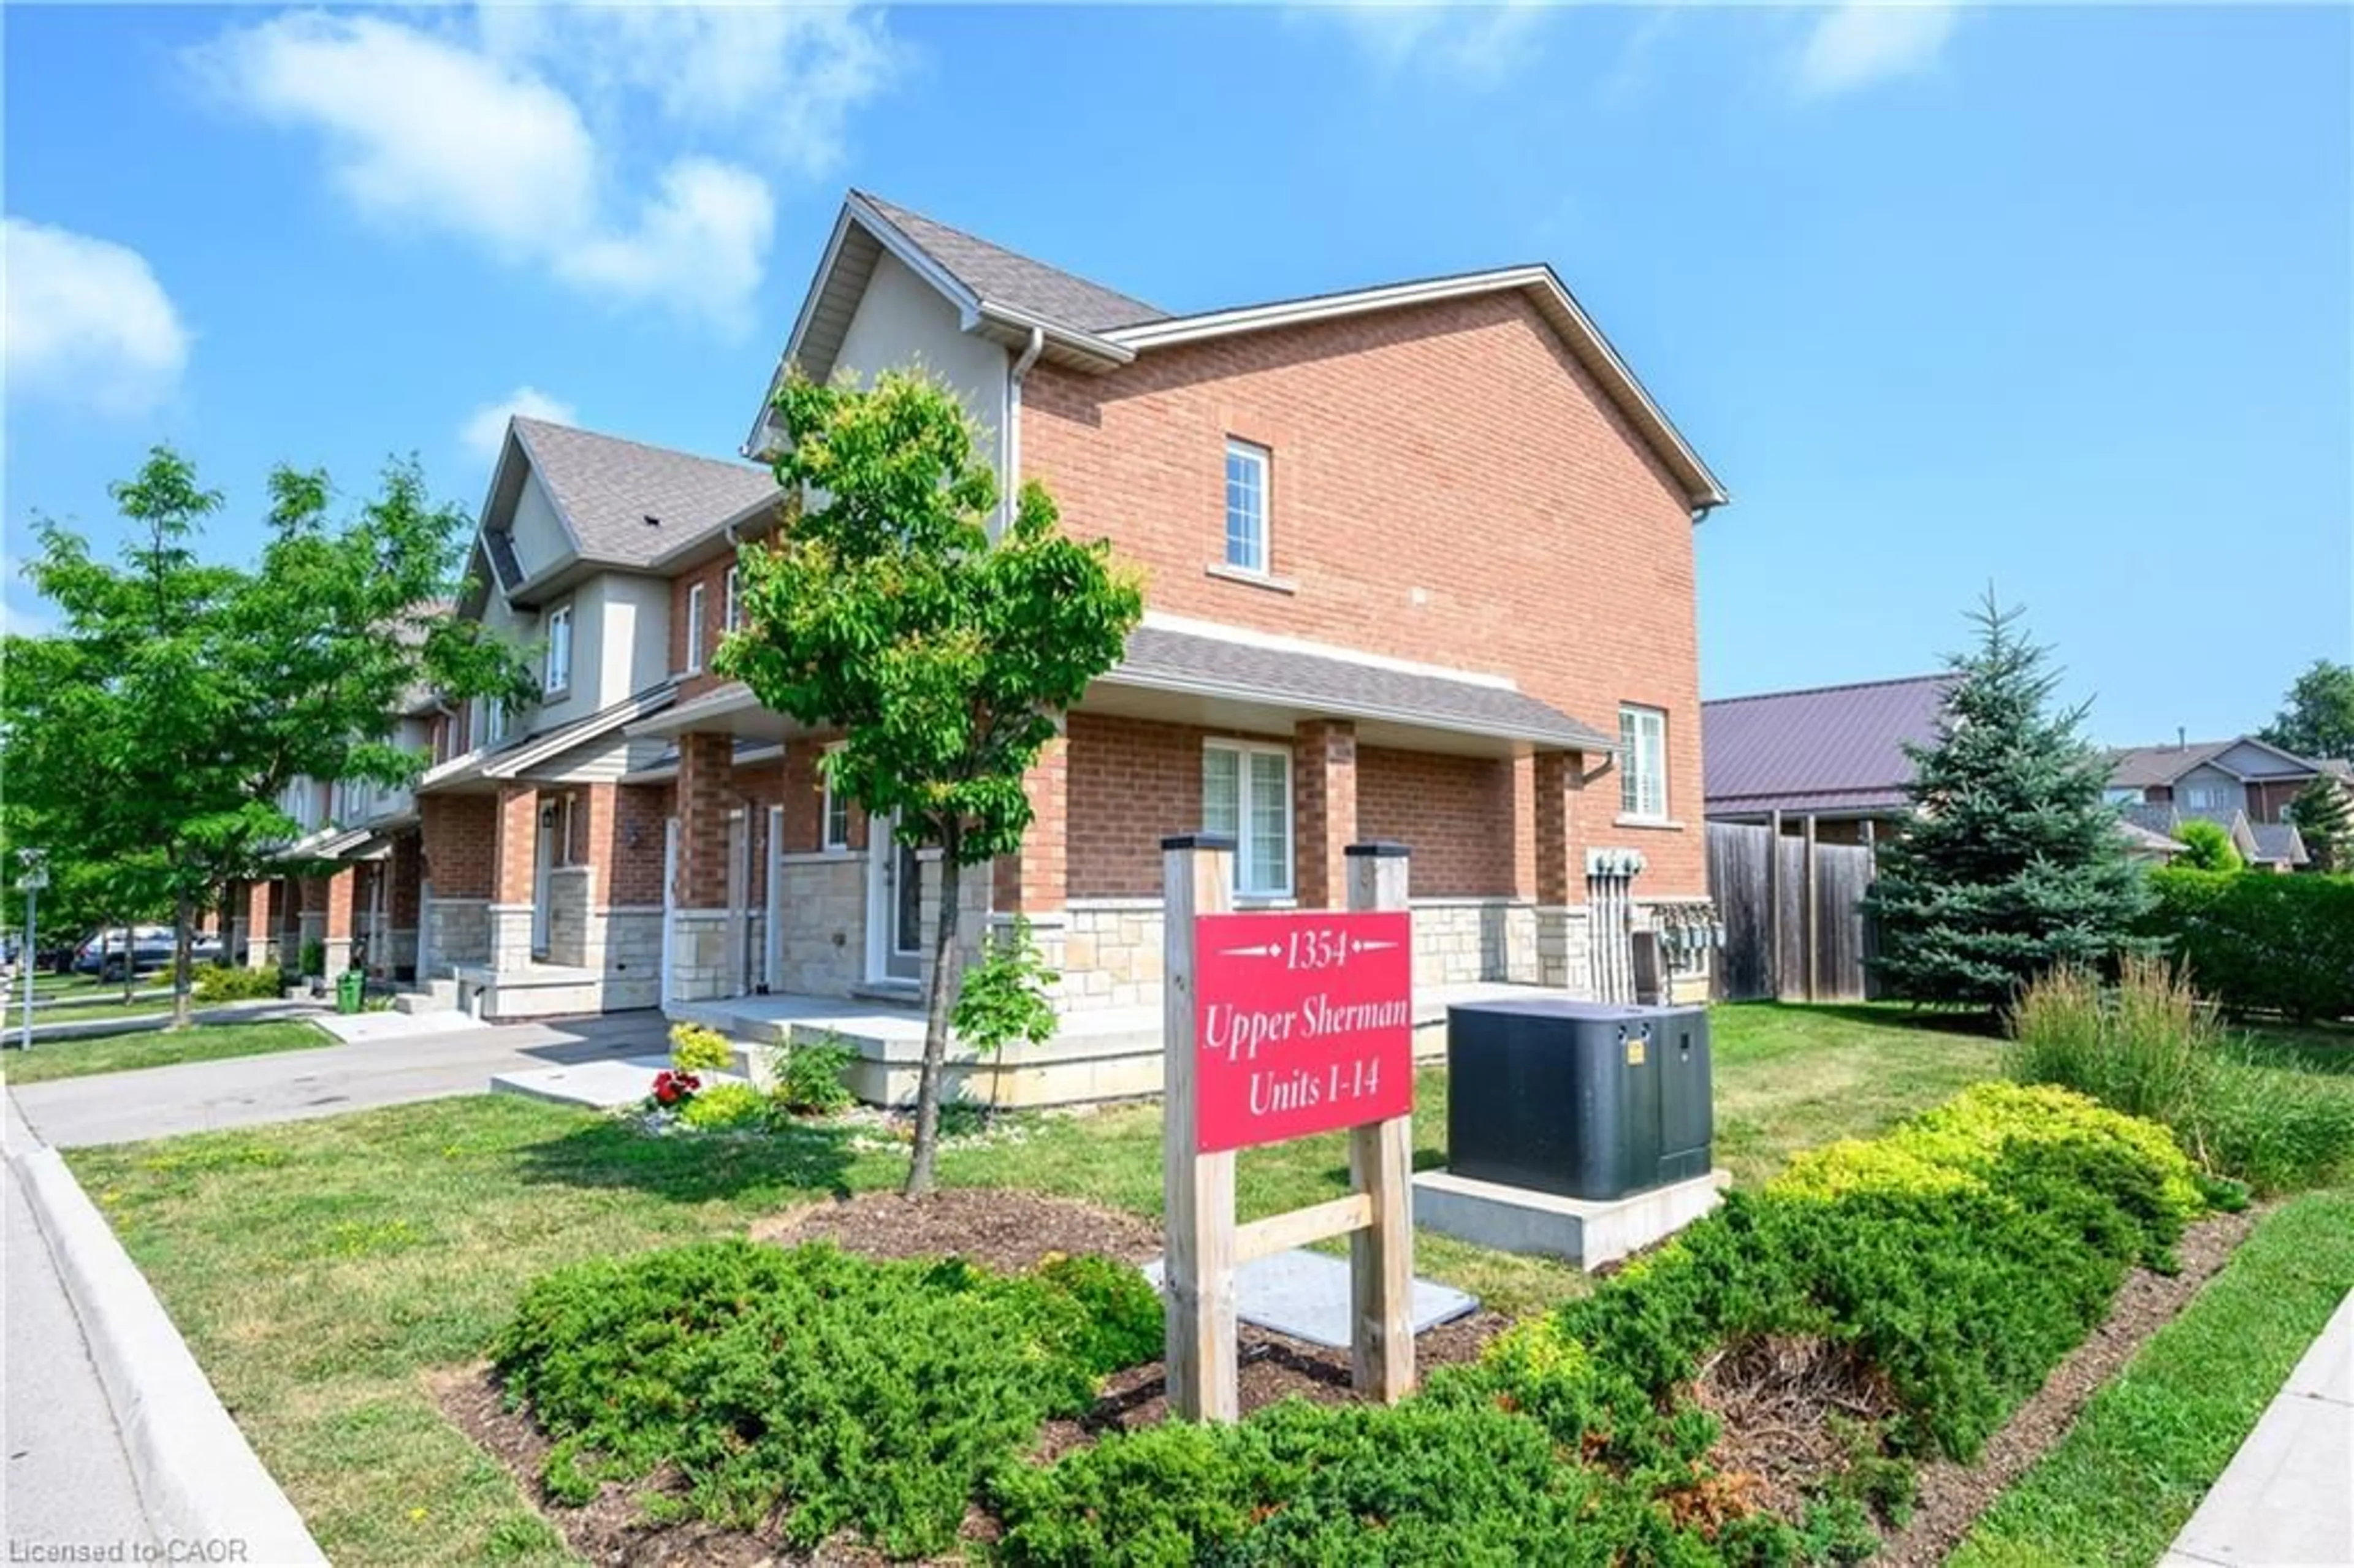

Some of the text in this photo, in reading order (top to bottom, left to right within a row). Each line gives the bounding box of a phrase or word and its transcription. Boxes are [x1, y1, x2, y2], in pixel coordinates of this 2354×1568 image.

[1287, 929, 1347, 970] 1354
[1203, 992, 1408, 1061] Upper Sherman
[1249, 1056, 1381, 1116] Units 1-14
